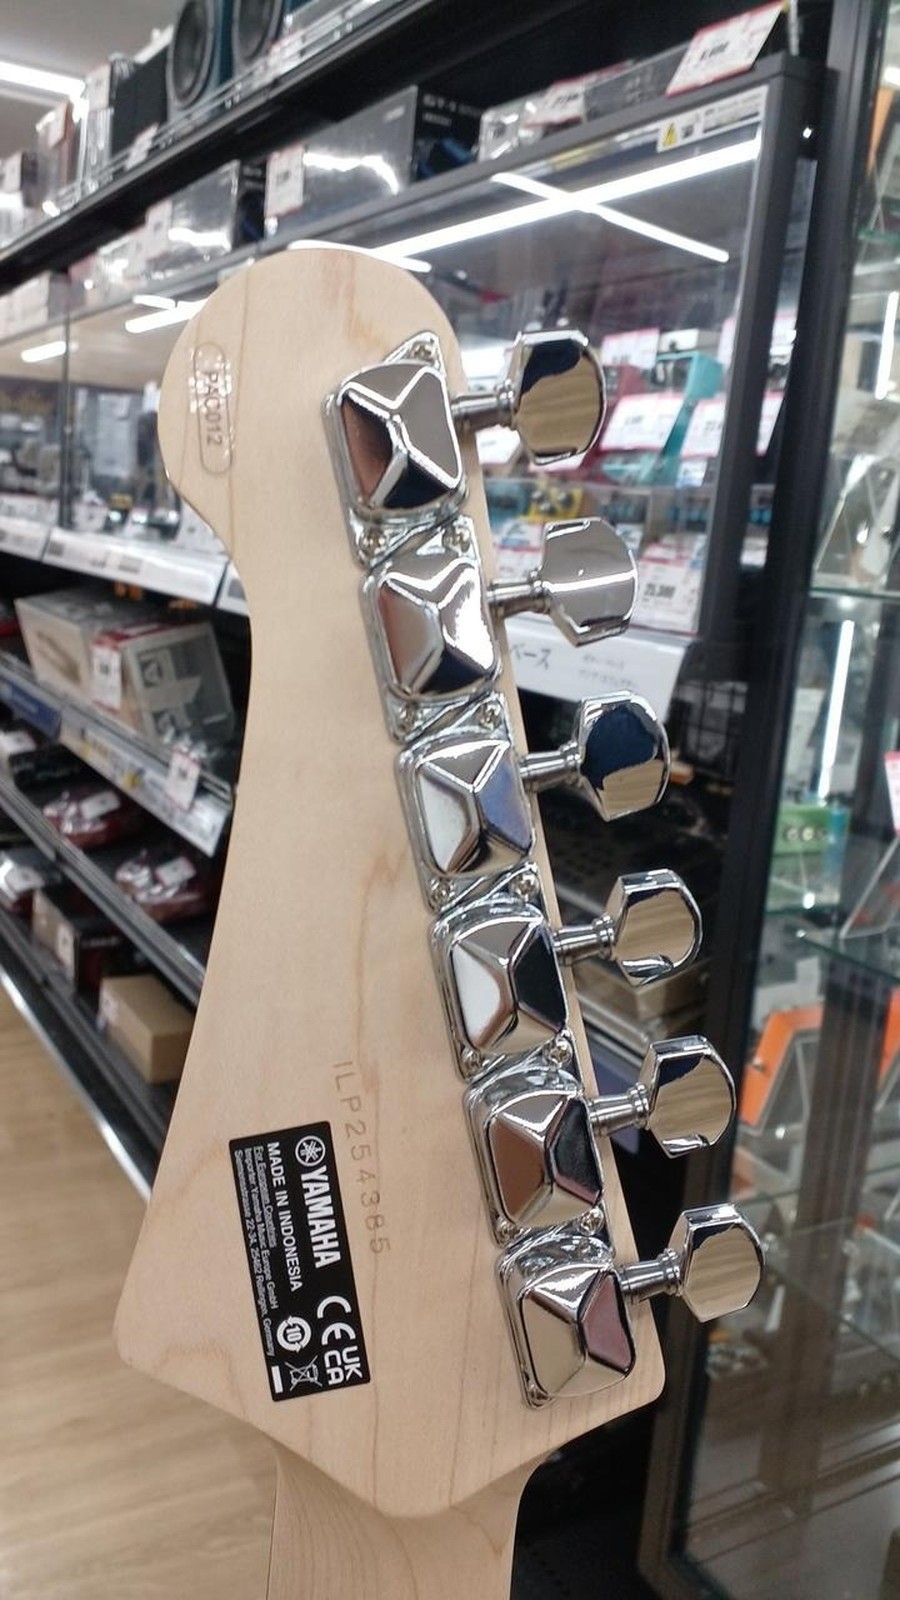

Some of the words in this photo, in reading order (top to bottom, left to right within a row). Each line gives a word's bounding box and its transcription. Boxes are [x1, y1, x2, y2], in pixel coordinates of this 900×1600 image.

[266, 1141, 286, 1187] MADE
[274, 1189, 289, 1207] IN
[299, 1165, 341, 1268] YAMAHA
[278, 1209, 303, 1291] INDONESIA
[284, 1323, 303, 1343] 10
[317, 1295, 356, 1345] CE
[323, 1348, 345, 1385] CA
[341, 1345, 362, 1381] UK
